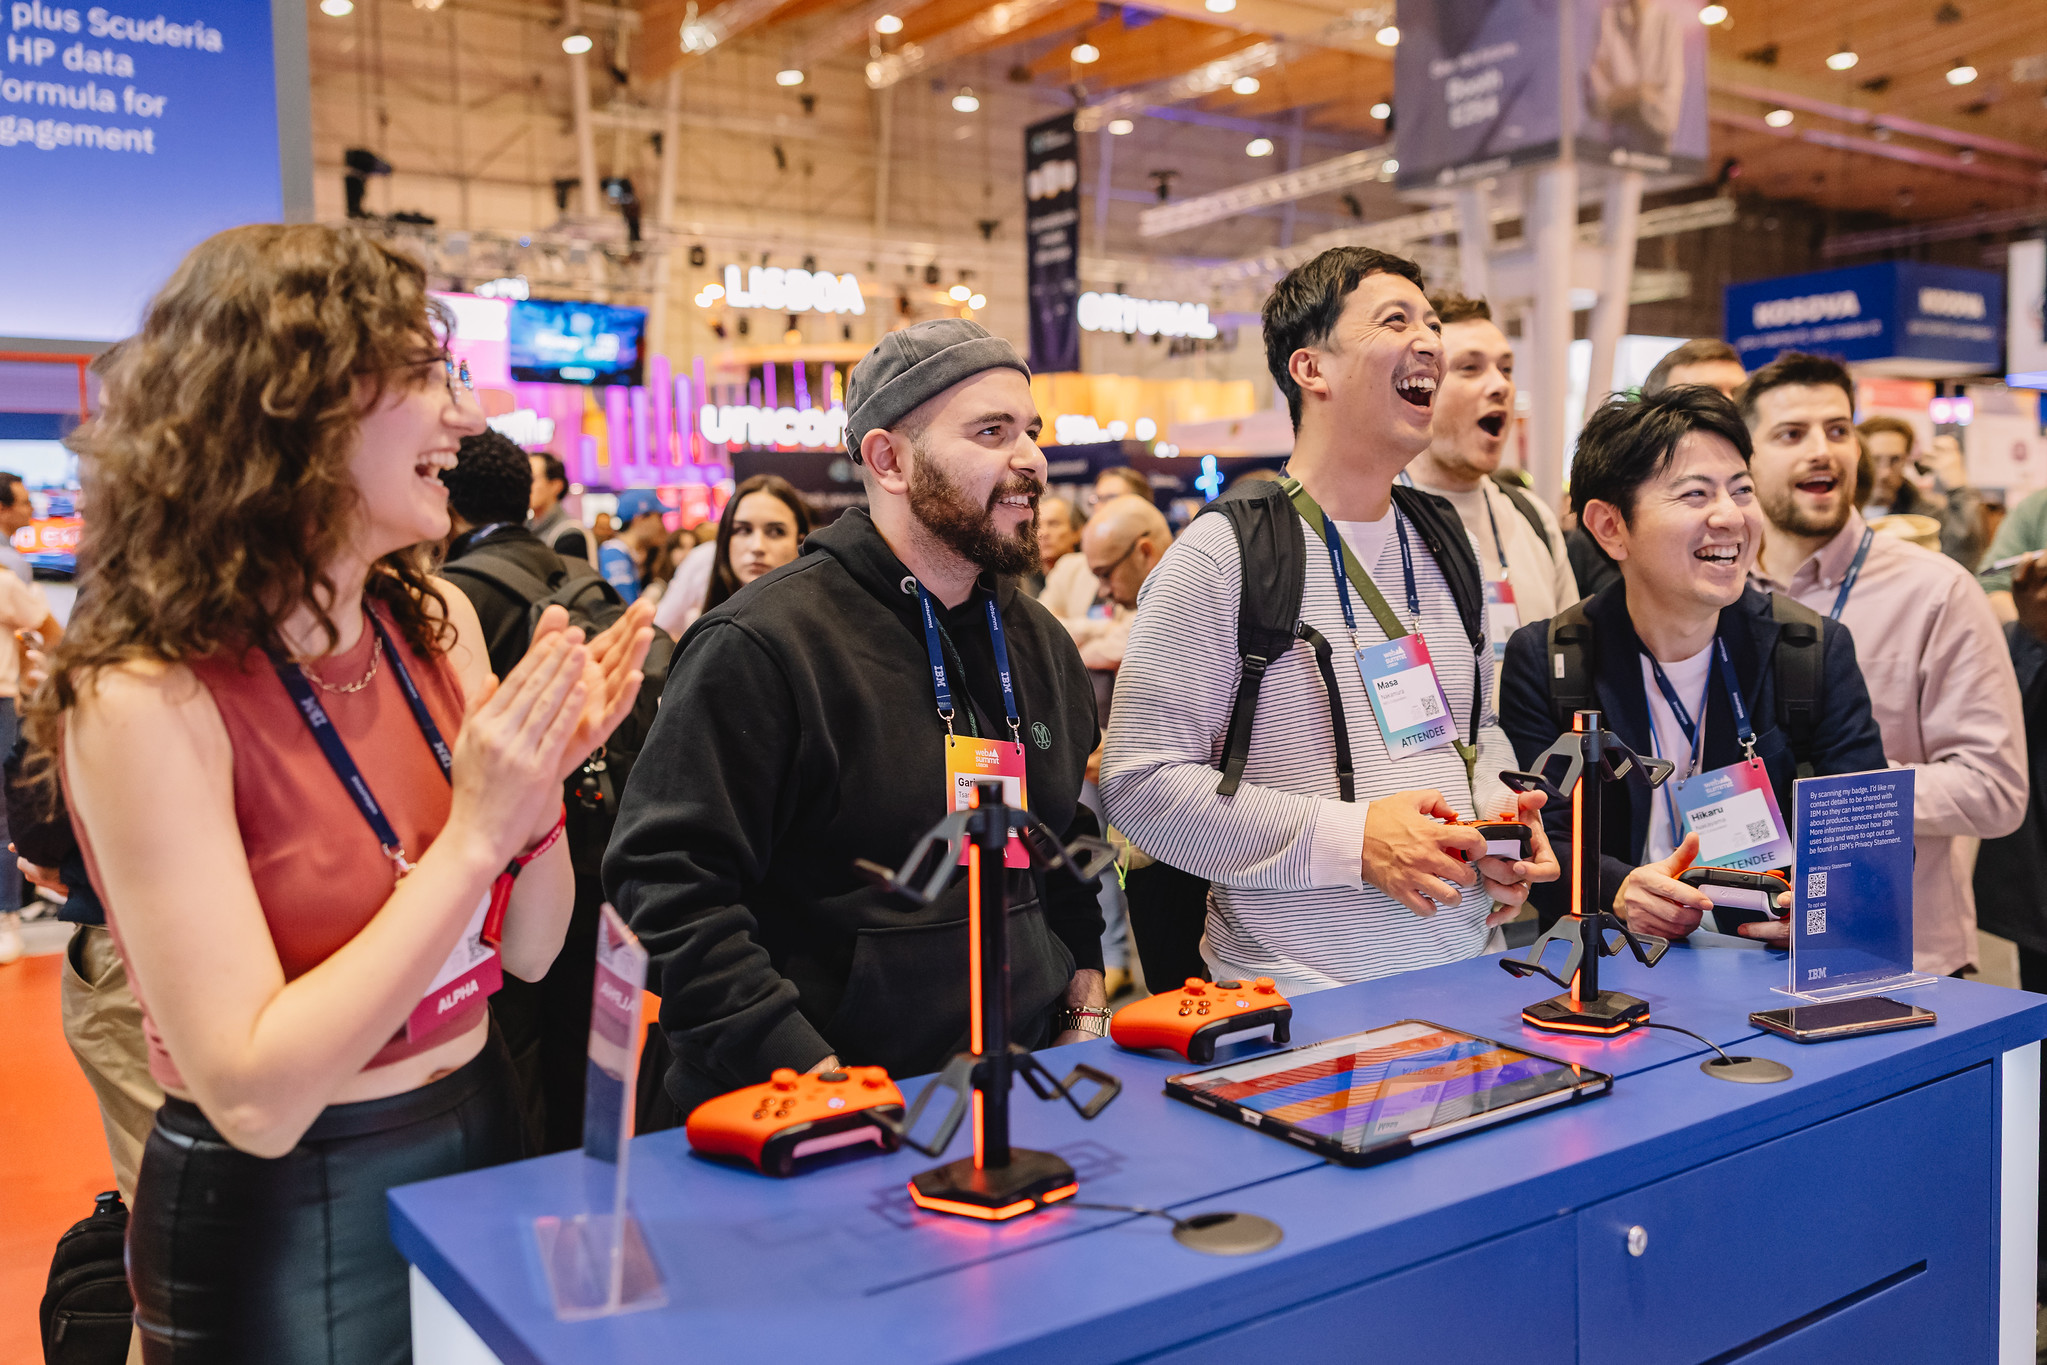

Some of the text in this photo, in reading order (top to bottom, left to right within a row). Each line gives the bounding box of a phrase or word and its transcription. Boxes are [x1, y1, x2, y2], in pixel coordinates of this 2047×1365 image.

[11, 0, 223, 53] plus Scuderia
[7, 34, 135, 78] HP data
[0, 76, 168, 119] ormula for
[934, 665, 946, 688] IBM
[1001, 671, 1012, 693] IBM
[1377, 680, 1398, 690] Masa
[1402, 726, 1446, 748] ATTENDEE
[976, 756, 999, 764] summit
[1810, 792, 1817, 800] By
[1818, 790, 1841, 798] scanning
[1810, 800, 1829, 808] contact
[1831, 798, 1848, 806] details
[1863, 794, 1880, 802] shared
[1875, 801, 1897, 809] informed
[1691, 807, 1724, 821] Hikaru
[1824, 825, 1853, 834] information
[1855, 822, 1869, 830] about
[1826, 817, 1850, 826] products,
[1817, 845, 1832, 853] found
[1839, 842, 1854, 850] IBM's
[1717, 851, 1776, 869] TTENDEE
[1808, 967, 1826, 980] IBM
[437, 978, 479, 1014] ALPHA
